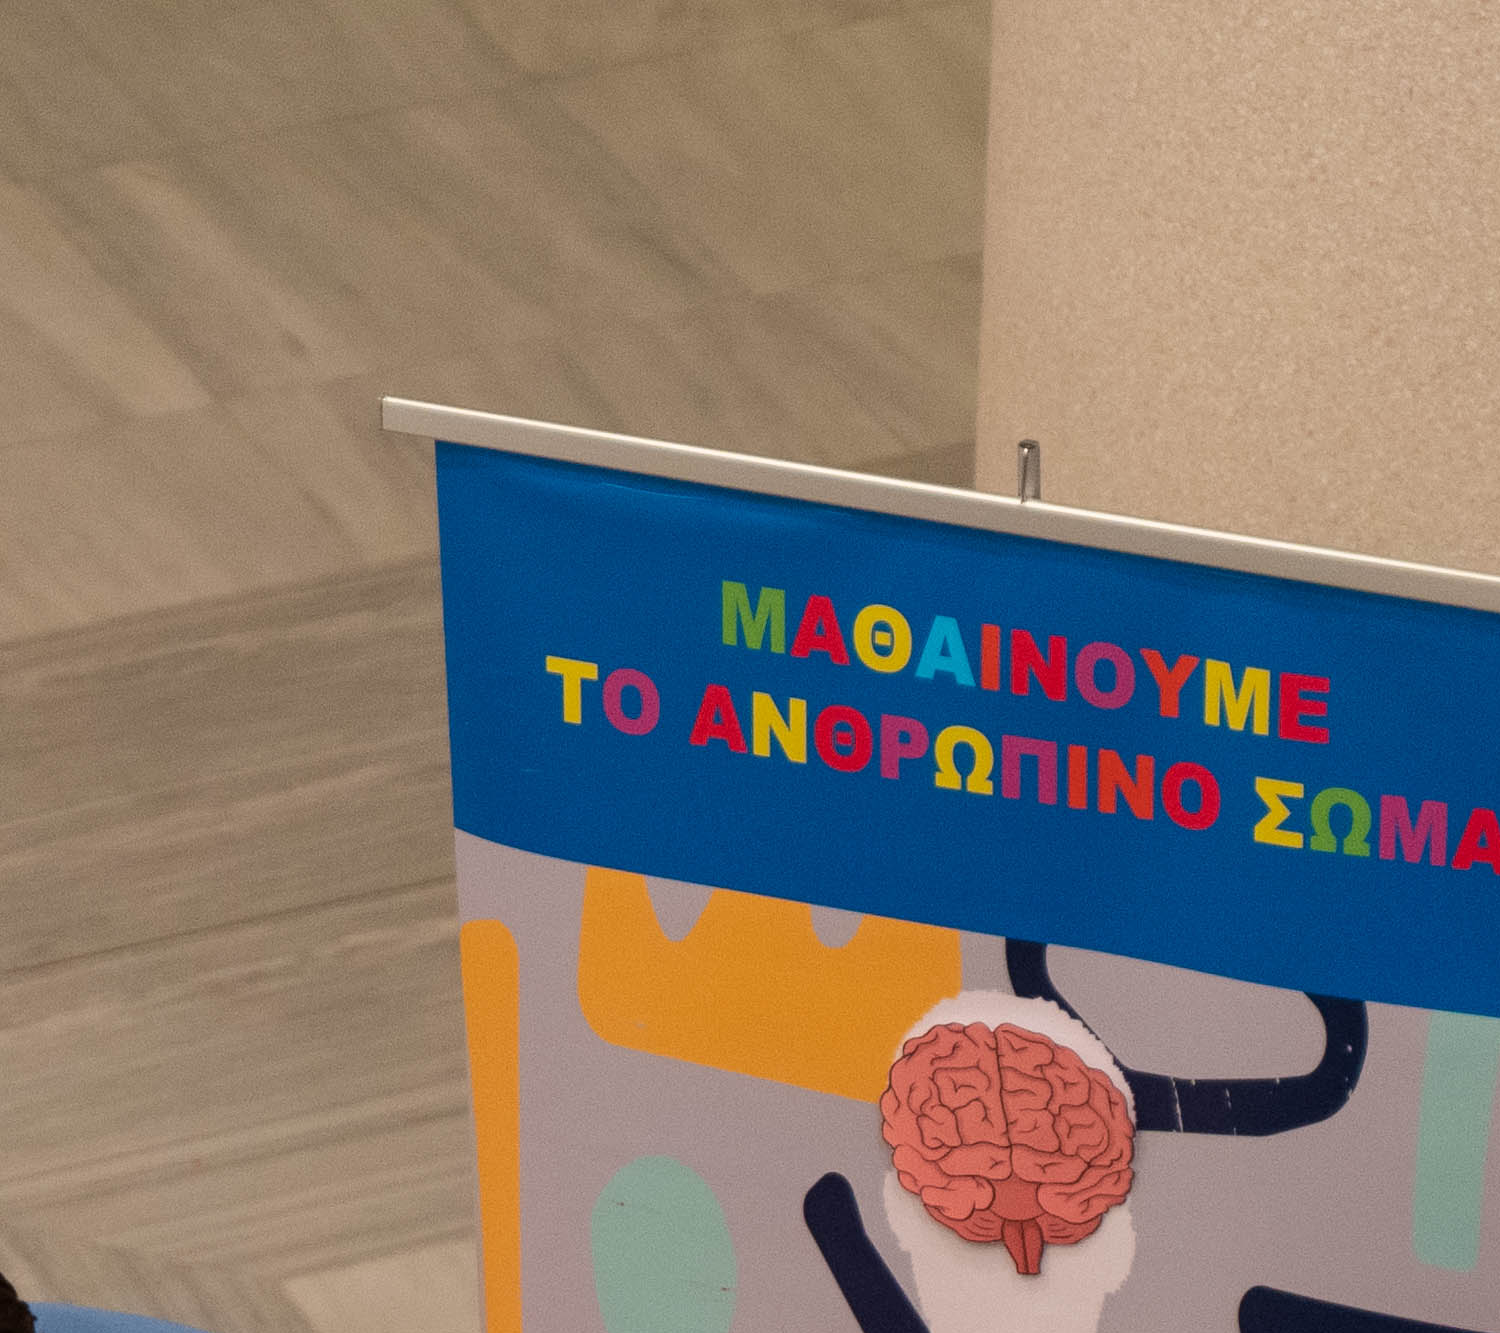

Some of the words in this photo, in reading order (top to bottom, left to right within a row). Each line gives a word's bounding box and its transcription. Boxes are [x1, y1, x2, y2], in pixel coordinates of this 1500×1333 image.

[546, 655, 661, 738] ΤΟ
[689, 683, 1222, 832] ΑΝΘΡΩΠΙΝΟ
[720, 579, 1331, 746] ΜΑΘΑΙΝΟΥΜΕ
